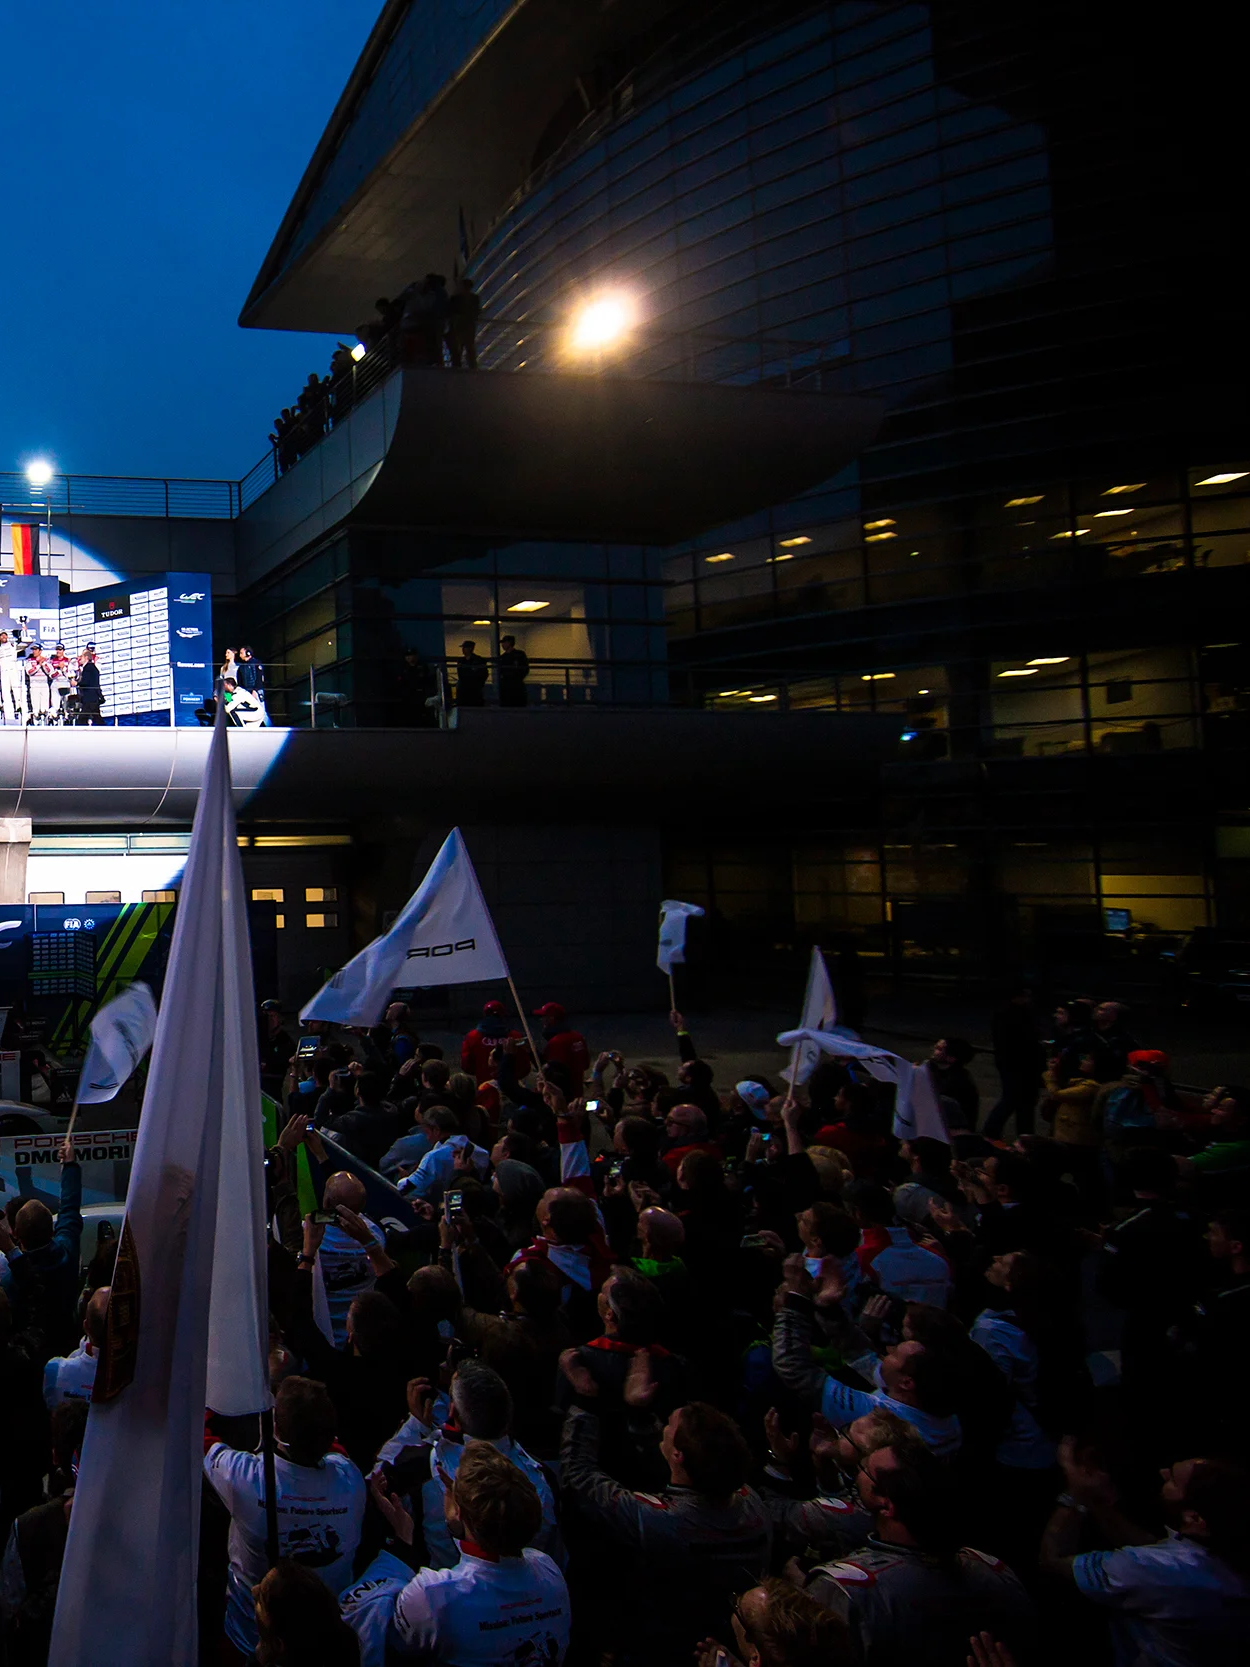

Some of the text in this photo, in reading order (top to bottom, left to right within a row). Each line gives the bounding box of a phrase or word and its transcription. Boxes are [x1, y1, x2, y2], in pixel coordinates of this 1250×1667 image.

[101, 608, 123, 618] TUDOR
[64, 919, 81, 930] FIA
[74, 1144, 130, 1161] MORI
[290, 1506, 314, 1515] Future
[316, 1506, 348, 1516] Sportscar
